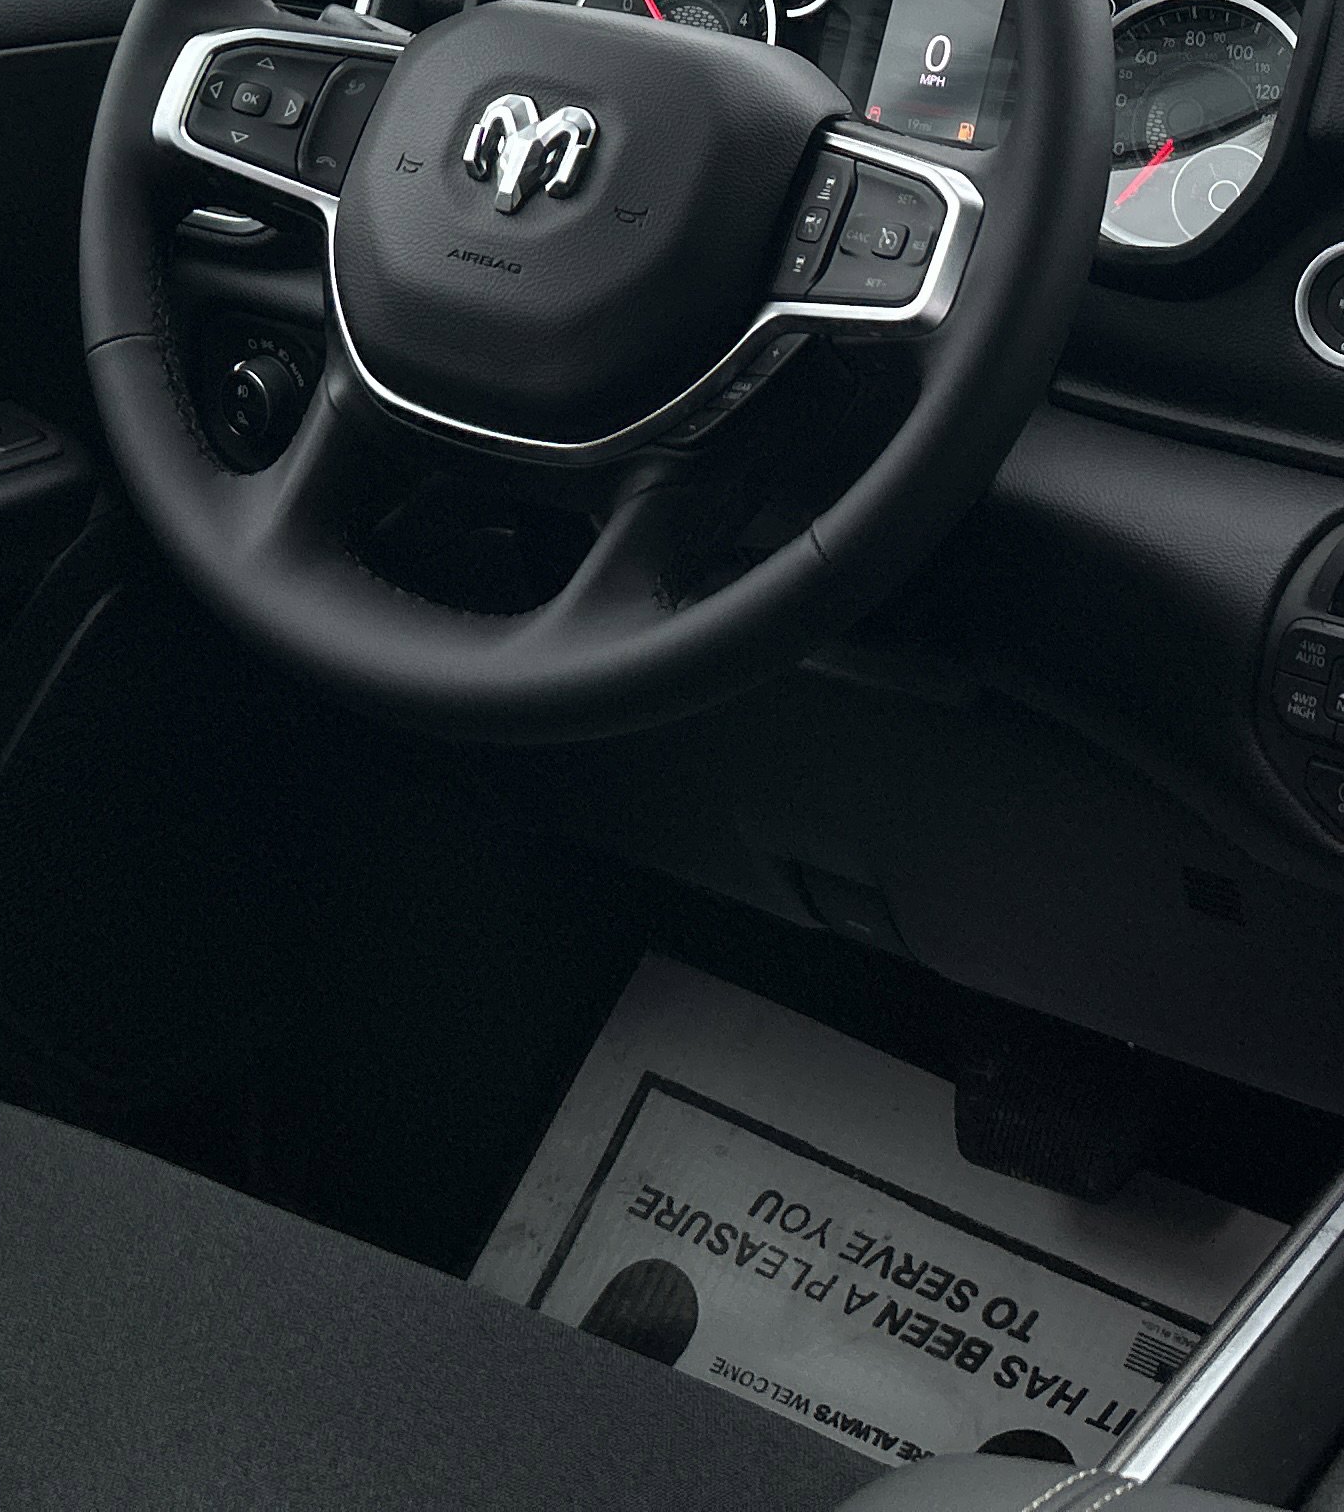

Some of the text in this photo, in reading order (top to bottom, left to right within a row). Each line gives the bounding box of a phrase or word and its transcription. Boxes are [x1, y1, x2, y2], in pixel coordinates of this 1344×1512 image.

[739, 11, 749, 27] 4
[1162, 37, 1176, 48] 70
[1184, 29, 1207, 48] 80
[1213, 31, 1227, 44] 90
[923, 33, 952, 73] 0
[1134, 48, 1158, 66] 60
[1225, 43, 1255, 62] 100
[919, 73, 946, 87] MPH
[1118, 68, 1133, 80] 50
[241, 91, 261, 106] OK
[1255, 83, 1282, 101] 120
[446, 248, 523, 275] AIRBAG
[1298, 638, 1327, 656] 4WD
[1295, 650, 1327, 668] AUTO
[1290, 690, 1319, 708] 4WD
[1287, 702, 1318, 721] HIGH
[747, 1188, 1040, 1344] TO SERVE YOU
[624, 1183, 1138, 1437] IT HAS BEEN A PLEASURE
[708, 1355, 811, 1415] WELCOME
[812, 1402, 900, 1452] ALWAYS
